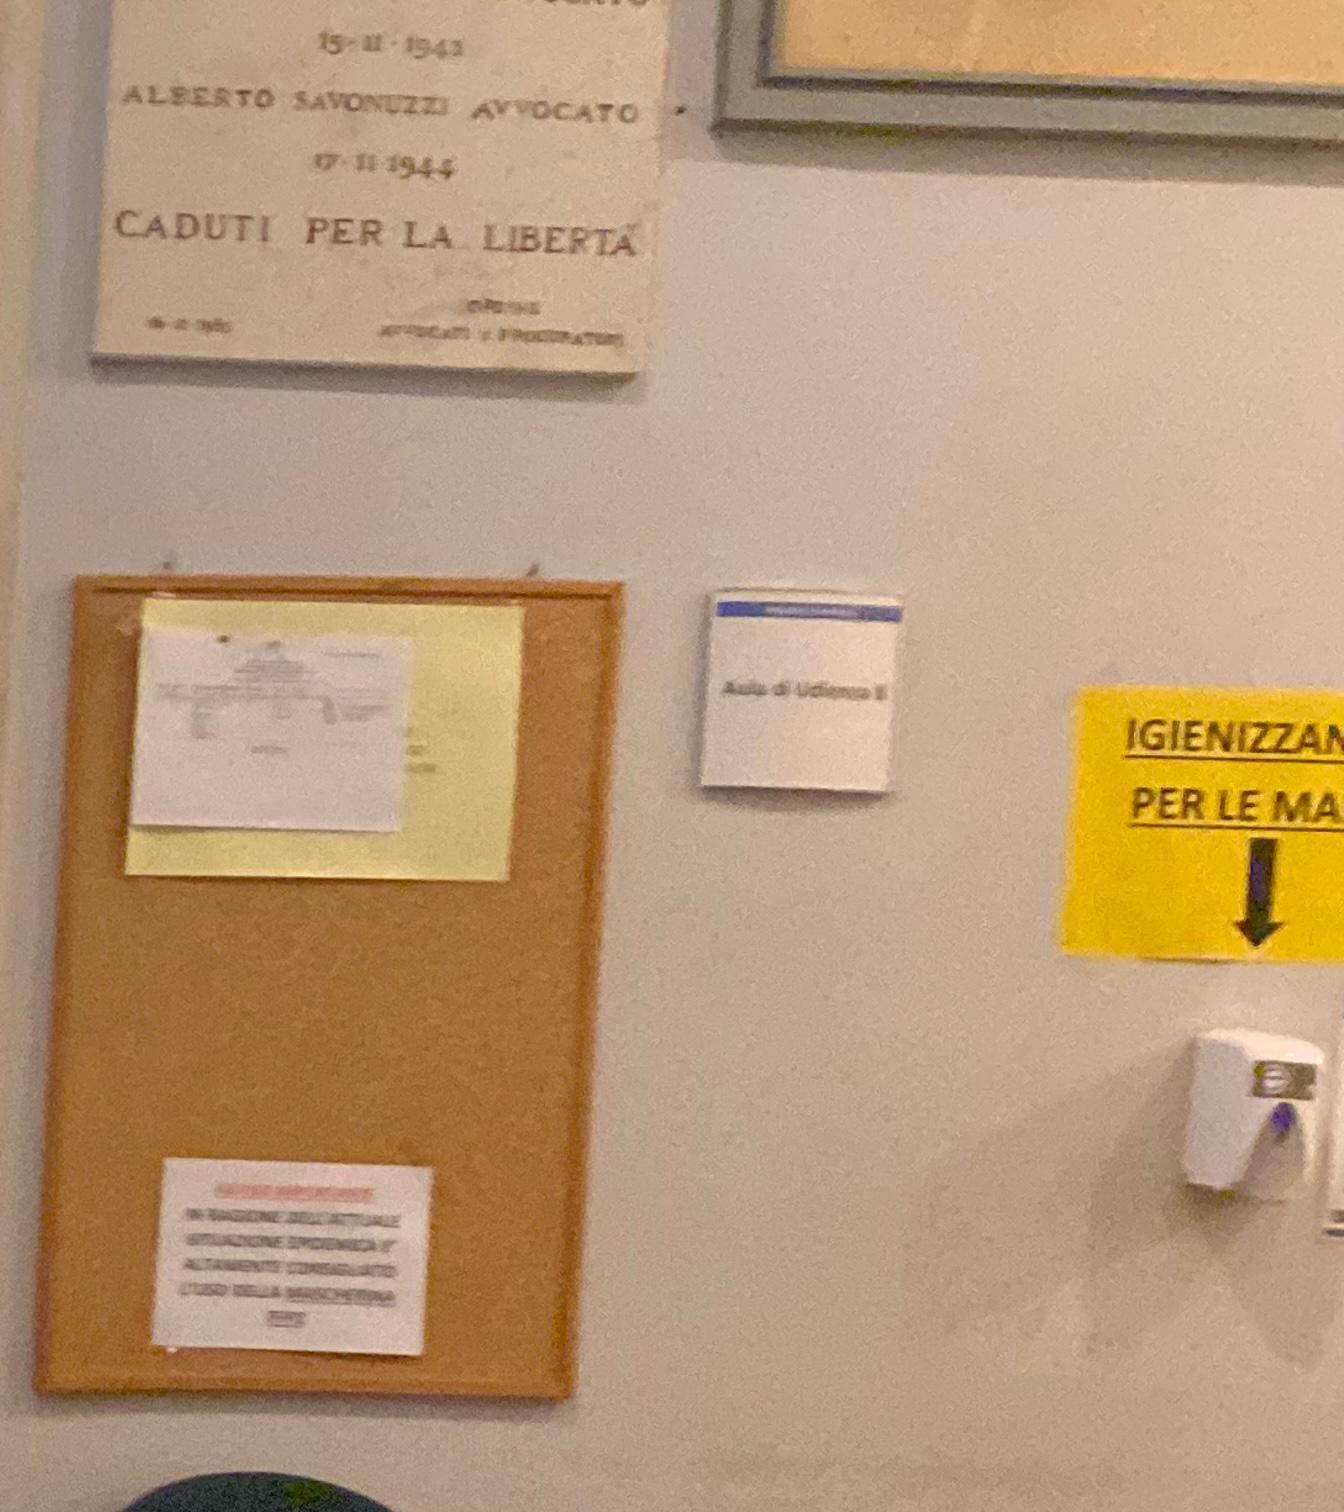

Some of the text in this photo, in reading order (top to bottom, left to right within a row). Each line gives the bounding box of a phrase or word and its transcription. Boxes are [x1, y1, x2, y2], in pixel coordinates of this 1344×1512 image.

[123, 84, 275, 108] ALBERTO
[470, 99, 639, 124] AVVOCATO
[115, 210, 270, 242] CADUTI
[305, 217, 383, 246] PER
[402, 221, 453, 249] LA
[1132, 787, 1206, 820] PER
[1218, 789, 1262, 822] LE
